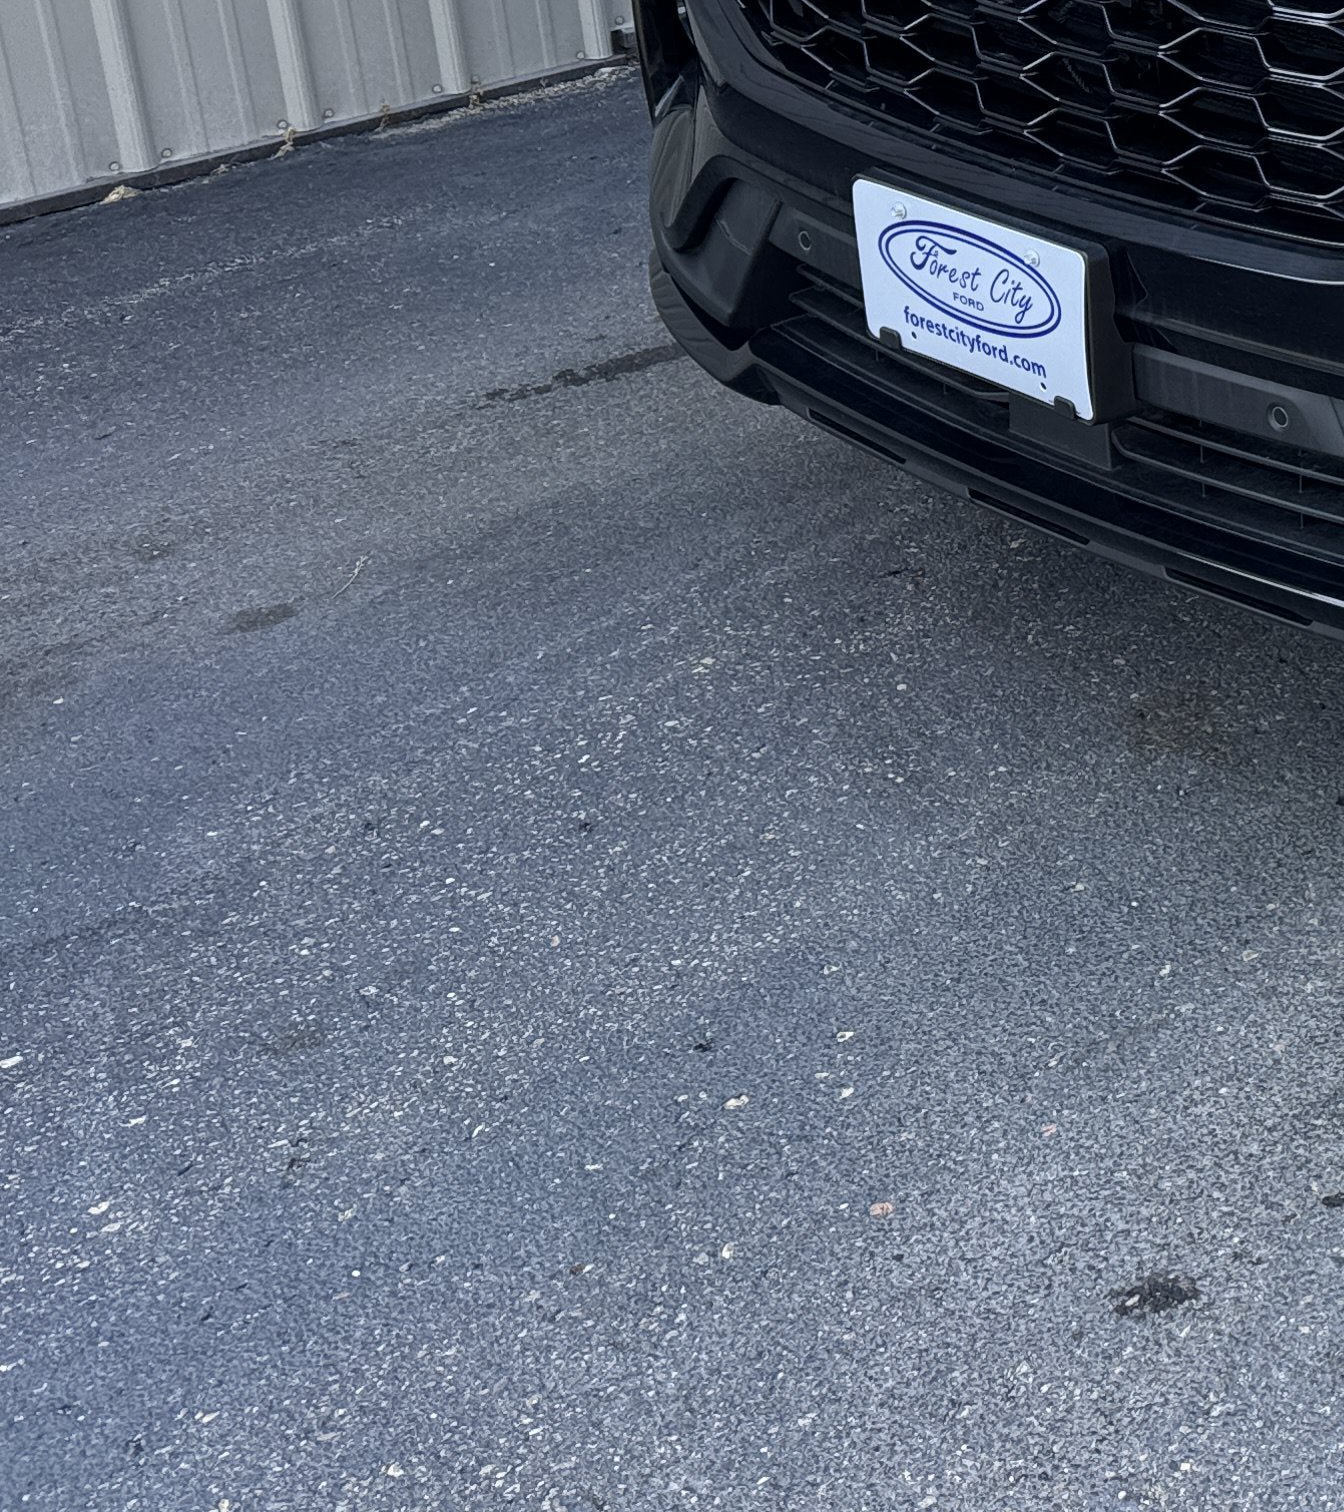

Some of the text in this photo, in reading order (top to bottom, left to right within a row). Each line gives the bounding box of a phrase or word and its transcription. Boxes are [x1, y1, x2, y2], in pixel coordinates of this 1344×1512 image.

[910, 235, 1034, 325] Forest City
[952, 291, 985, 312] FORD
[903, 305, 1048, 378] forestcityford.com
